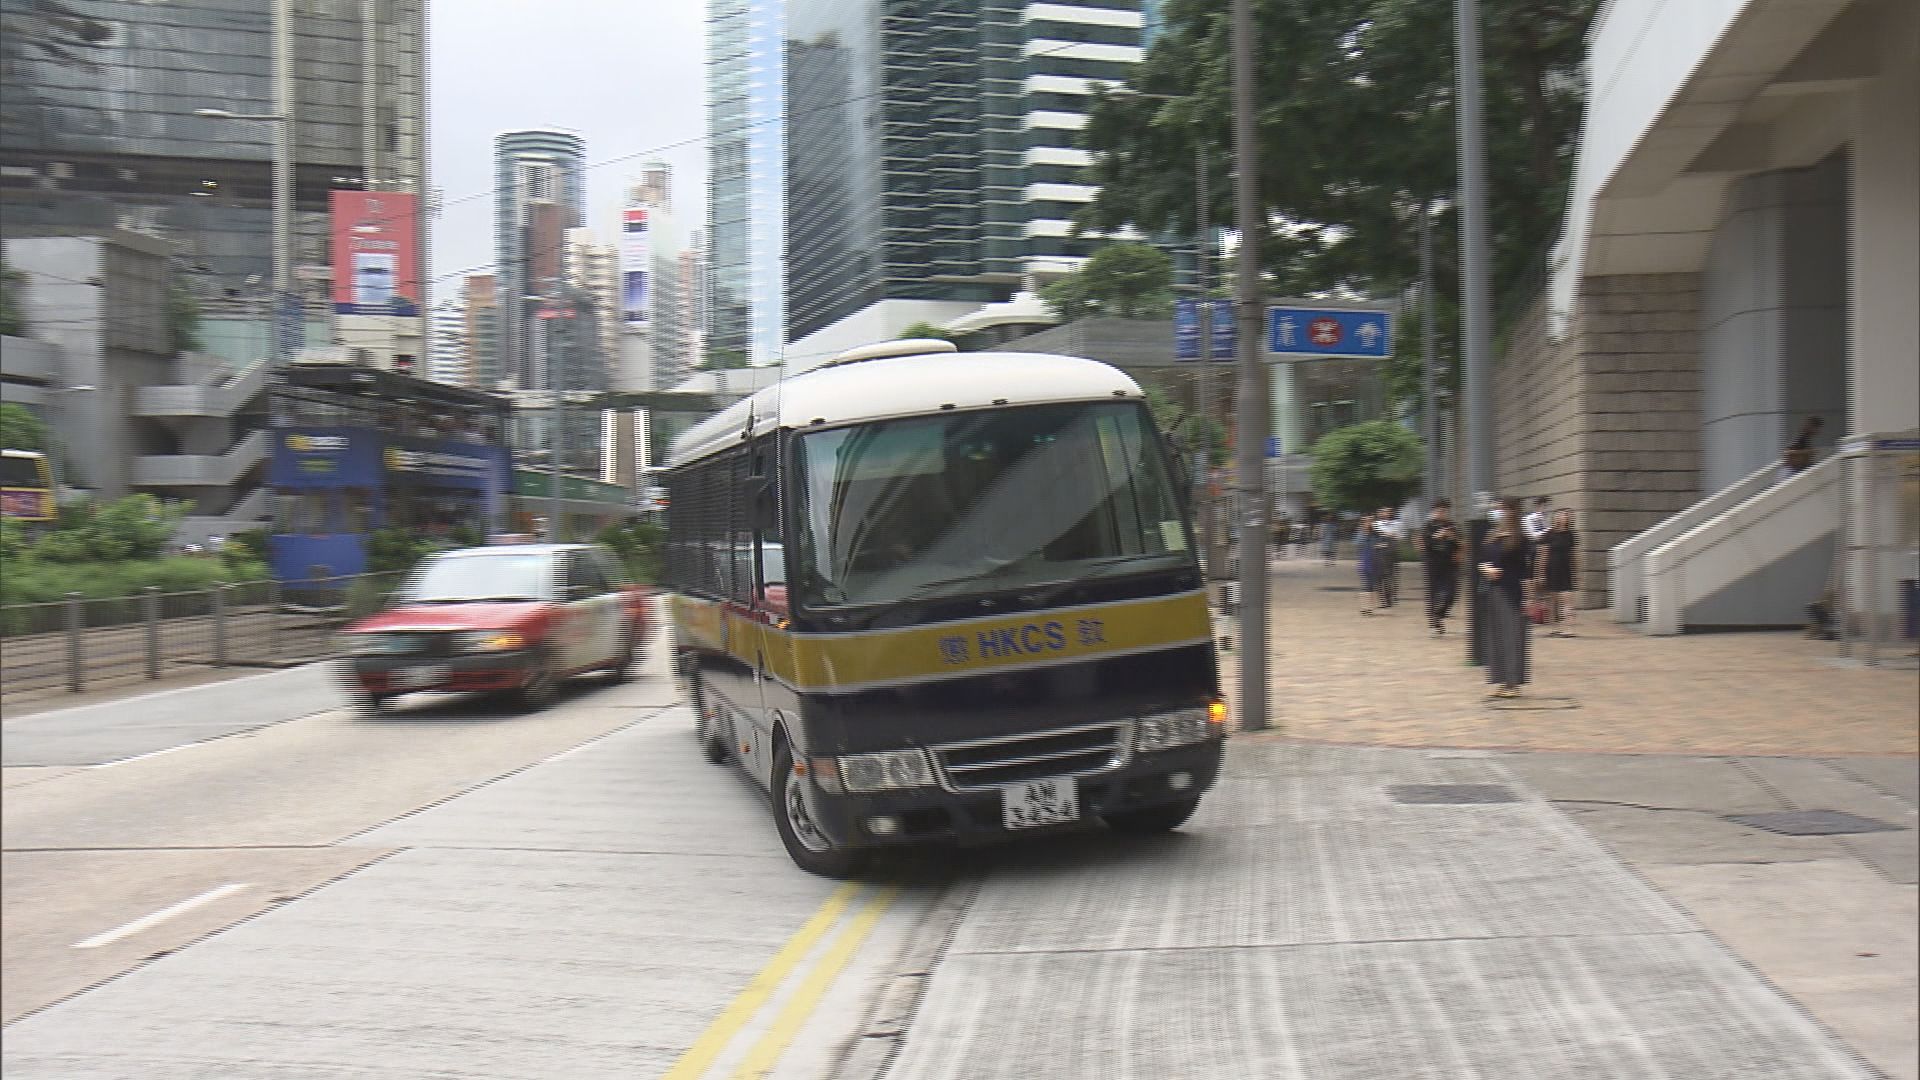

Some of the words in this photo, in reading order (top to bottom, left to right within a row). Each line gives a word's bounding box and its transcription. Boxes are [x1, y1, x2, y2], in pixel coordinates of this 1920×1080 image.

[977, 621, 1066, 657] HKCS
[1025, 781, 1057, 804] AM
[1008, 800, 1074, 826] 3454
